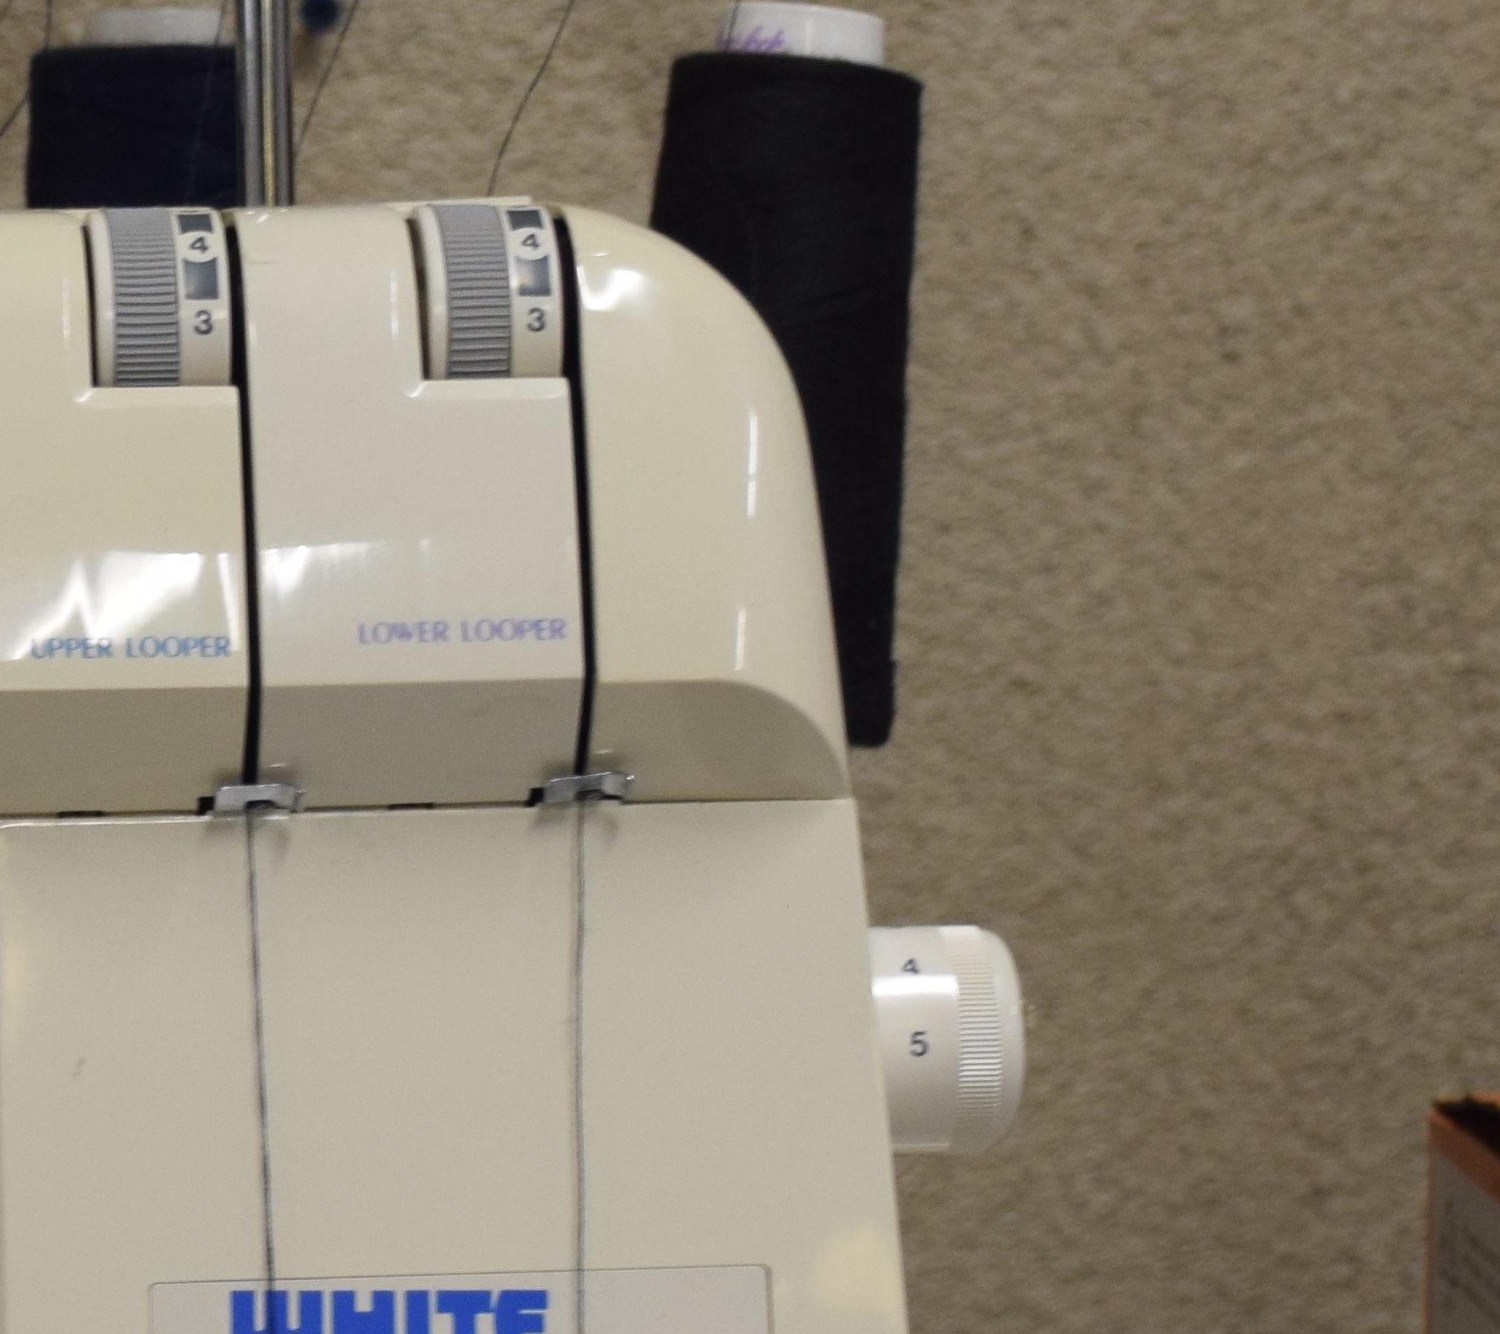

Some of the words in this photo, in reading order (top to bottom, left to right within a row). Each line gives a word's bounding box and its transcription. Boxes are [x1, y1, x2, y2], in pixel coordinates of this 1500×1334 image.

[188, 236, 210, 254] 4
[521, 233, 542, 251] 4
[194, 311, 213, 335] 3
[527, 308, 546, 332] 3
[357, 621, 450, 645] LOWER
[461, 618, 567, 642] LOOPER
[30, 637, 114, 659] UPPER
[126, 635, 232, 658] LOOPER
[909, 1031, 930, 1057] 5
